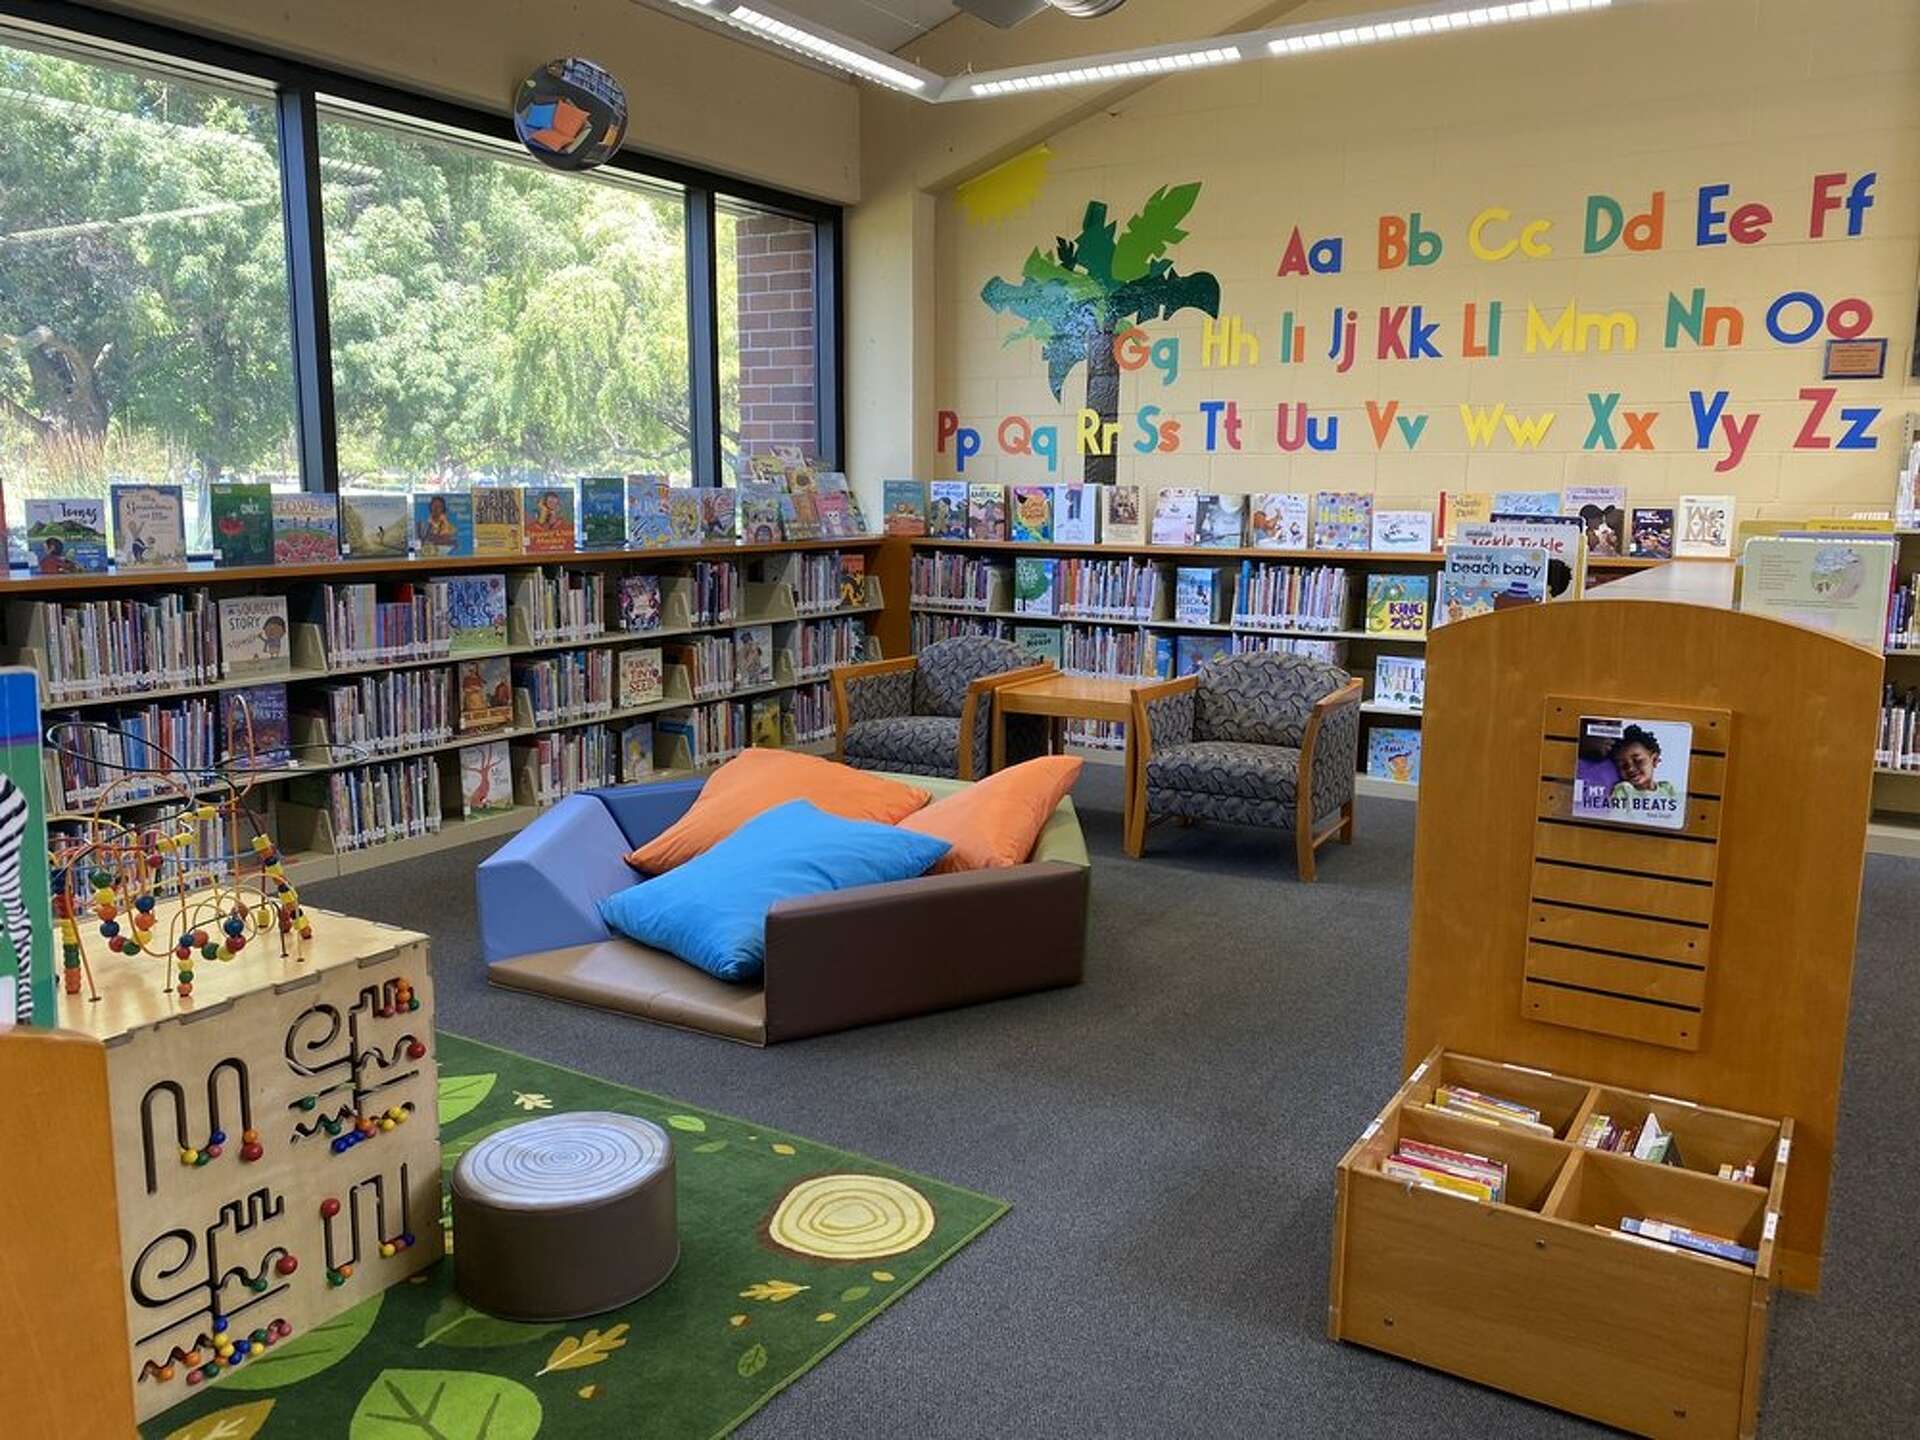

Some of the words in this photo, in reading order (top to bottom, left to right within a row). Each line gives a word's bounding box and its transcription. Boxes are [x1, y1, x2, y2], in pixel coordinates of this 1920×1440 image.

[1277, 225, 1343, 277] Aa
[1378, 213, 1442, 270] Bb
[1467, 207, 1553, 261] Cc
[1583, 191, 1665, 254] Dd
[1696, 184, 1773, 246] Ee
[1809, 172, 1876, 238] Ff
[1113, 327, 1180, 386] Gg
[1201, 314, 1259, 368] Hh
[1328, 306, 1358, 373] Jj
[1377, 305, 1442, 360] Kk
[1462, 301, 1502, 358] Ll
[1526, 298, 1637, 354] Mm
[1664, 288, 1744, 349] Nn
[1766, 291, 1873, 344] Oo
[937, 411, 982, 472] Pp
[997, 416, 1058, 472] Qq
[1076, 408, 1123, 456] Rr
[1133, 405, 1181, 454] Ss
[1199, 401, 1242, 451] Tt
[1276, 402, 1338, 452] Uu
[1365, 400, 1429, 451] Vv
[1459, 402, 1556, 450] Ww
[1583, 392, 1659, 451] Xx
[1689, 391, 1761, 474] Yy
[1793, 388, 1882, 450] Zz
[1518, 536, 1564, 554] Tickle
[1451, 560, 1499, 574] beach
[1502, 560, 1542, 579] baby
[229, 615, 262, 631] STORY
[1389, 616, 1424, 631] ZOO
[1588, 785, 1606, 796] MY
[1583, 796, 1629, 810] HEART
[1632, 798, 1677, 812] BEATS
